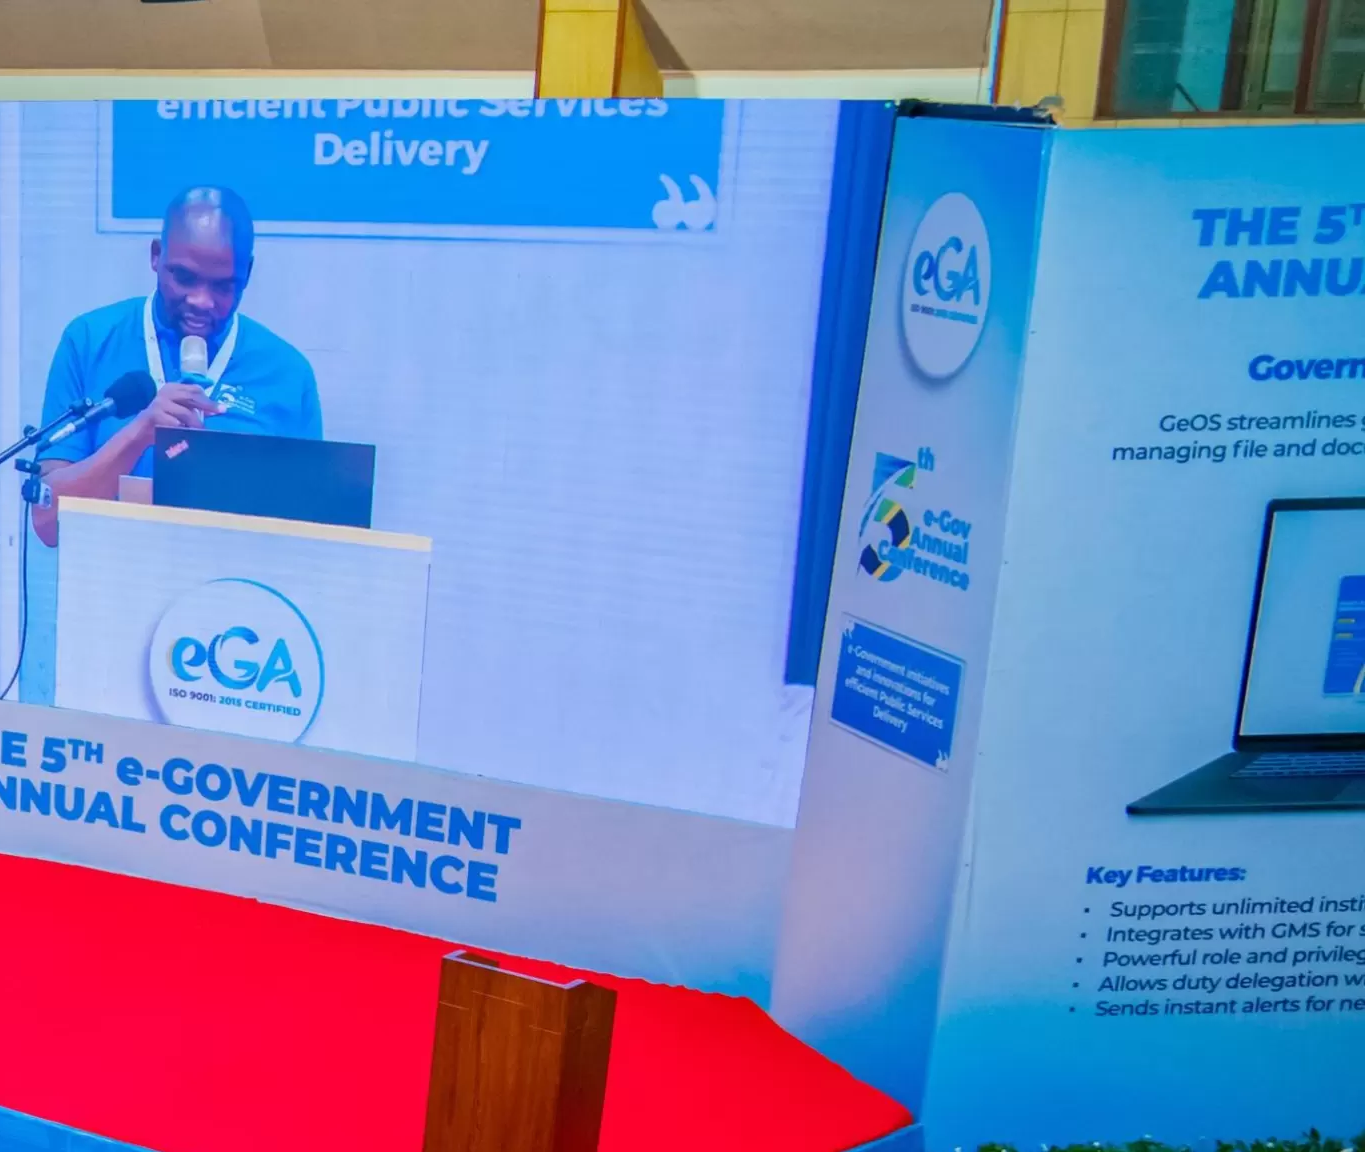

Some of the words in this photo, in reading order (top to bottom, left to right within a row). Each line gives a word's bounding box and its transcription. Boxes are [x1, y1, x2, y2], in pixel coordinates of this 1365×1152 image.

[313, 129, 490, 175] Delivery
[1191, 206, 1301, 247] THE
[912, 236, 981, 306] eGA
[1197, 257, 1365, 299] ANNU
[1159, 413, 1222, 433] GeOS
[1226, 410, 1357, 431] streamlines
[1112, 440, 1227, 464] managing
[1232, 439, 1268, 458] file
[1273, 438, 1317, 457] and
[923, 509, 972, 539] e-Gov
[910, 526, 969, 565] Annual
[878, 540, 970, 591] Conference
[171, 626, 302, 698] eGA
[169, 688, 187, 698] ISO
[189, 691, 216, 703] 9001:
[219, 695, 242, 707] 2015
[245, 699, 301, 716] CERTIFIED
[856, 665, 871, 679] and
[922, 692, 936, 706] for
[873, 706, 908, 733] Delivery
[880, 691, 906, 712] Public
[907, 703, 944, 729] Services
[40, 736, 104, 773] 5TH
[116, 756, 522, 855] e-GOVERNMENT
[159, 804, 499, 902] CONFERENCE
[1086, 866, 1133, 888] Key
[1136, 865, 1247, 883] Features:
[1110, 901, 1206, 920] Supports
[1212, 897, 1313, 916] unlimited
[1107, 925, 1213, 945] Integrates
[1219, 923, 1265, 941] with
[1271, 922, 1322, 939] GMS
[1325, 920, 1355, 938] for
[1103, 948, 1197, 967] Powerful
[1202, 948, 1241, 965] role
[1246, 947, 1286, 964] and
[1097, 975, 1168, 992] Allows
[1172, 974, 1220, 994] duty
[1225, 971, 1338, 992] delegation
[1095, 1000, 1159, 1016] Sends
[1164, 999, 1236, 1016] instant
[1241, 997, 1300, 1014] alerts
[1305, 996, 1334, 1012] for
